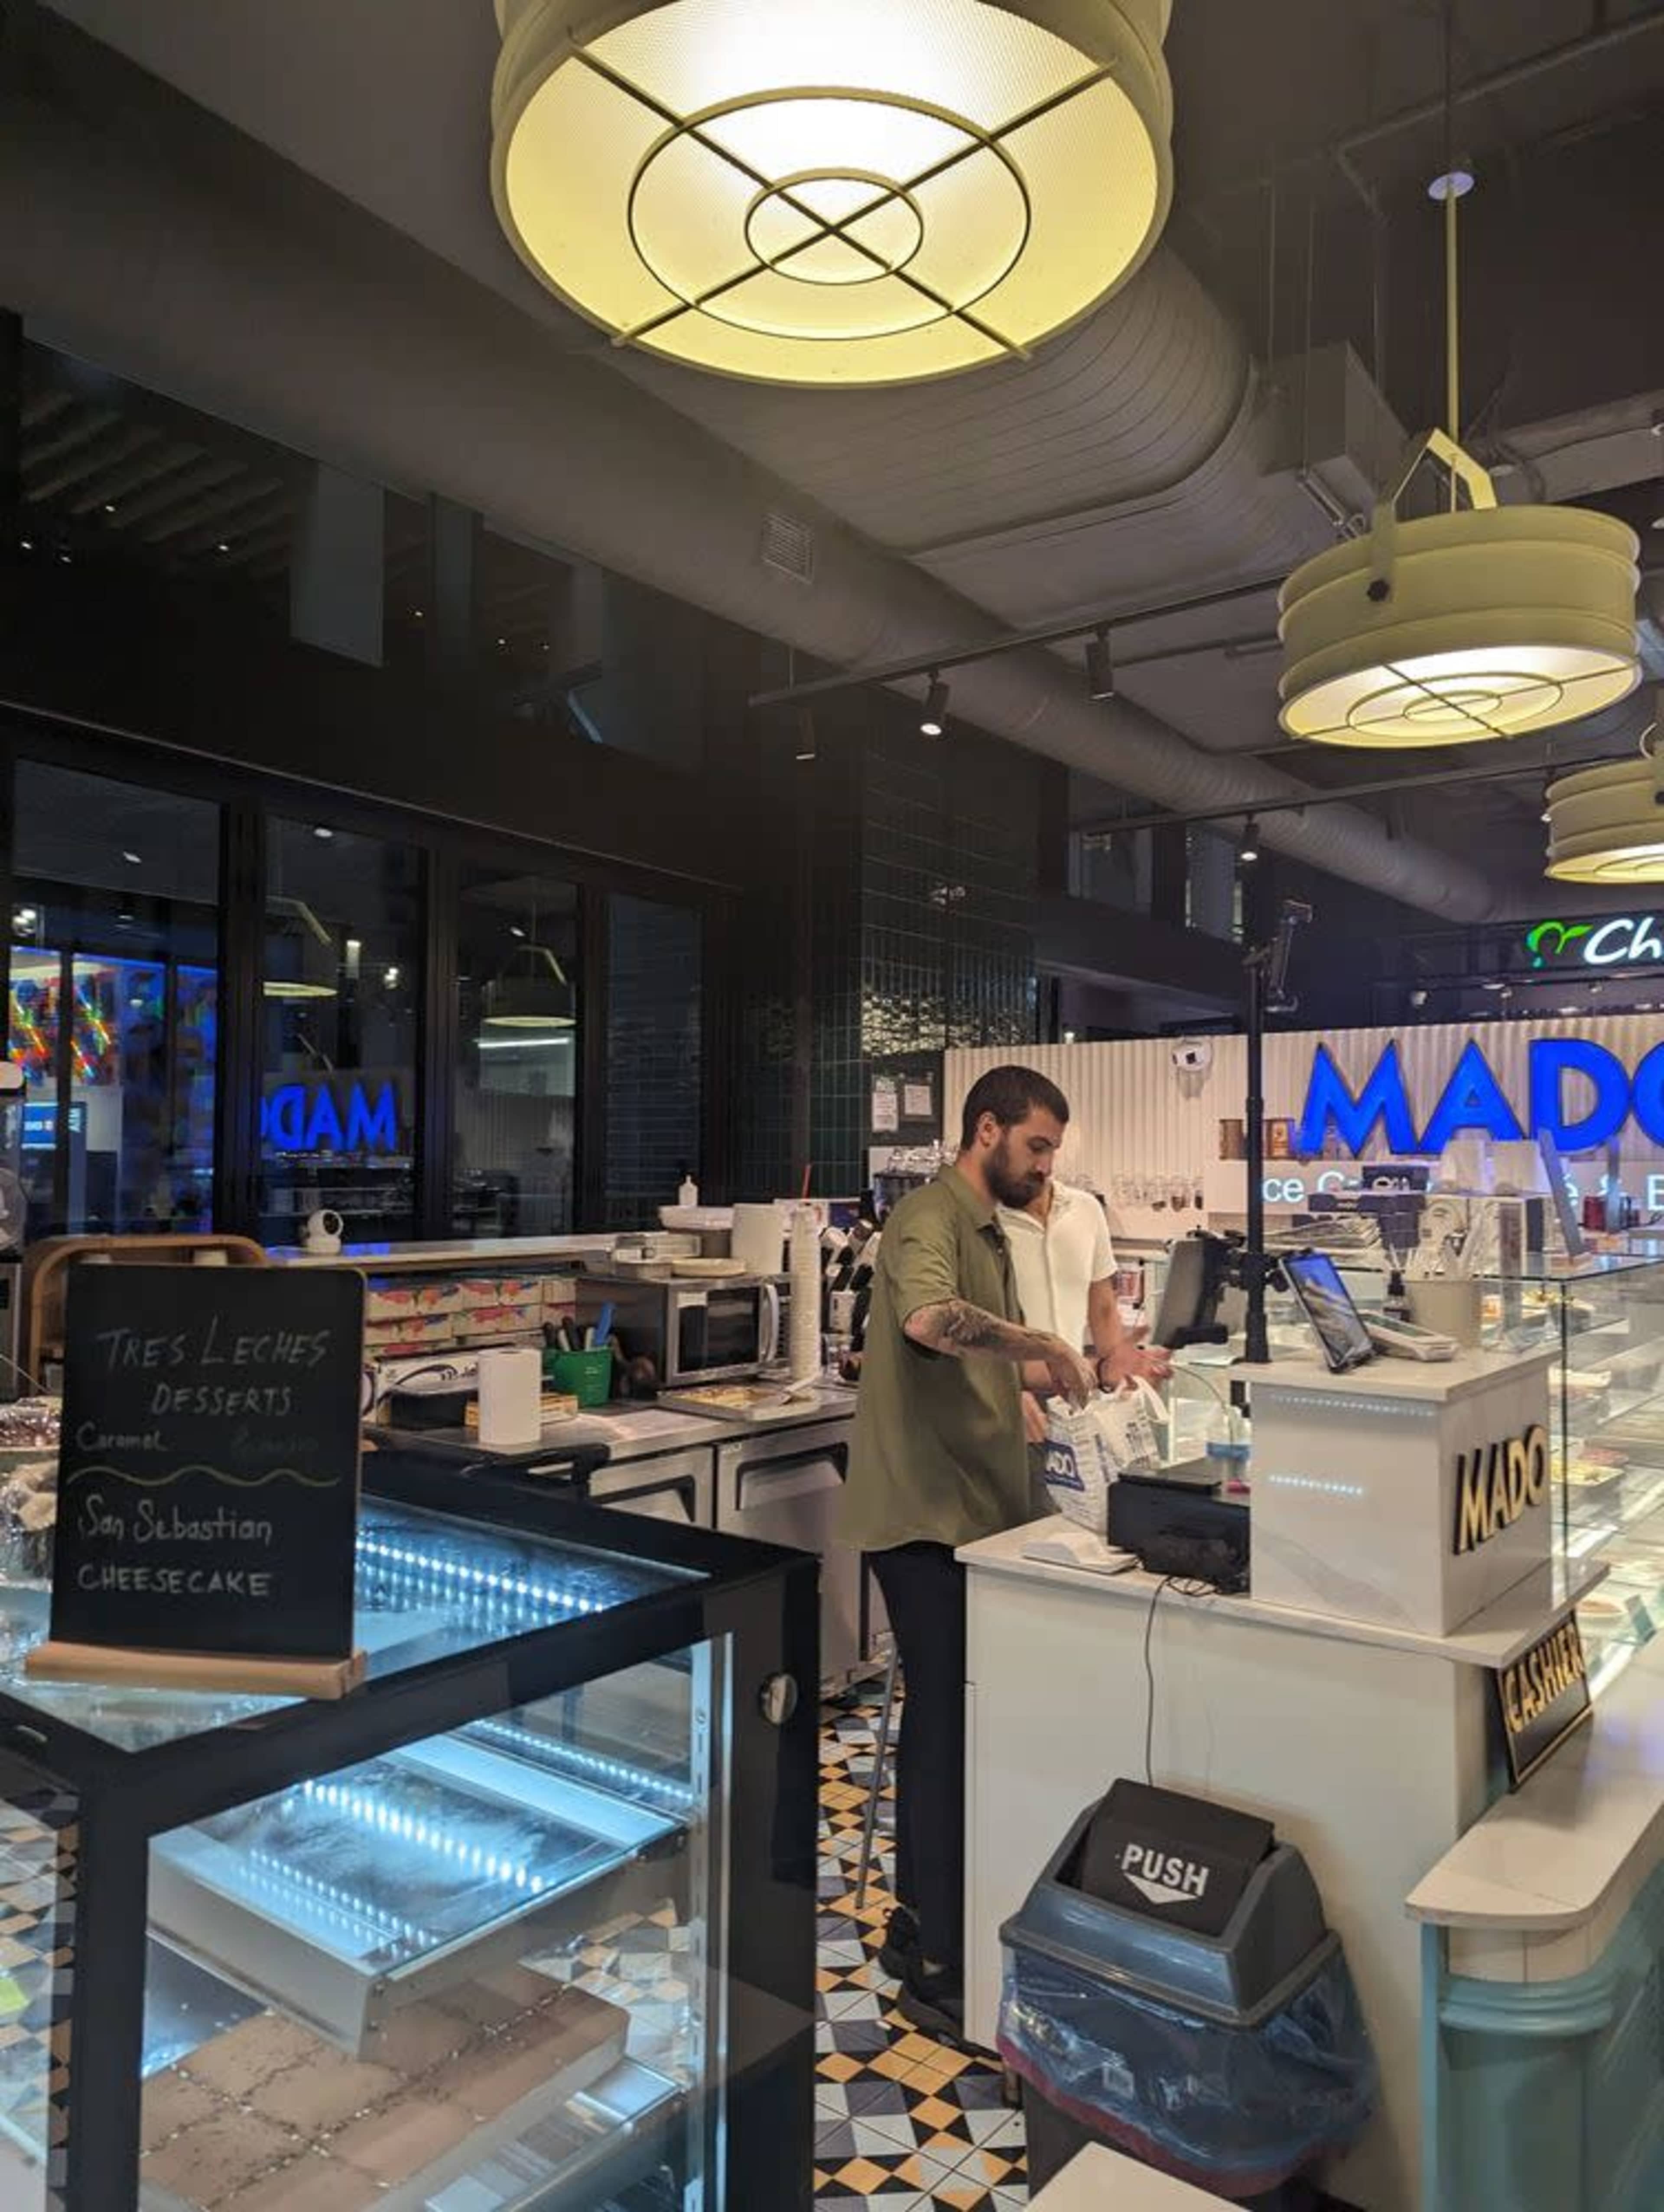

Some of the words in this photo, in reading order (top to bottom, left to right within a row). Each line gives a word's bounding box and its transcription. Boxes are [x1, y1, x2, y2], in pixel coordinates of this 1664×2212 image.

[1299, 1038, 1664, 1156] MAD
[1262, 1177, 1305, 1203] ce
[97, 1328, 186, 1371] TRES
[201, 1313, 332, 1368] LECHES
[151, 1383, 291, 1416] DESSERTS
[1453, 1424, 1547, 1555] MADO
[78, 1495, 126, 1541] San
[132, 1499, 273, 1547] Sebastian
[77, 1564, 274, 1596] CHEESECAKE
[1505, 1623, 1585, 1732] CASHIER
[1121, 1843, 1210, 1896] PUSH
